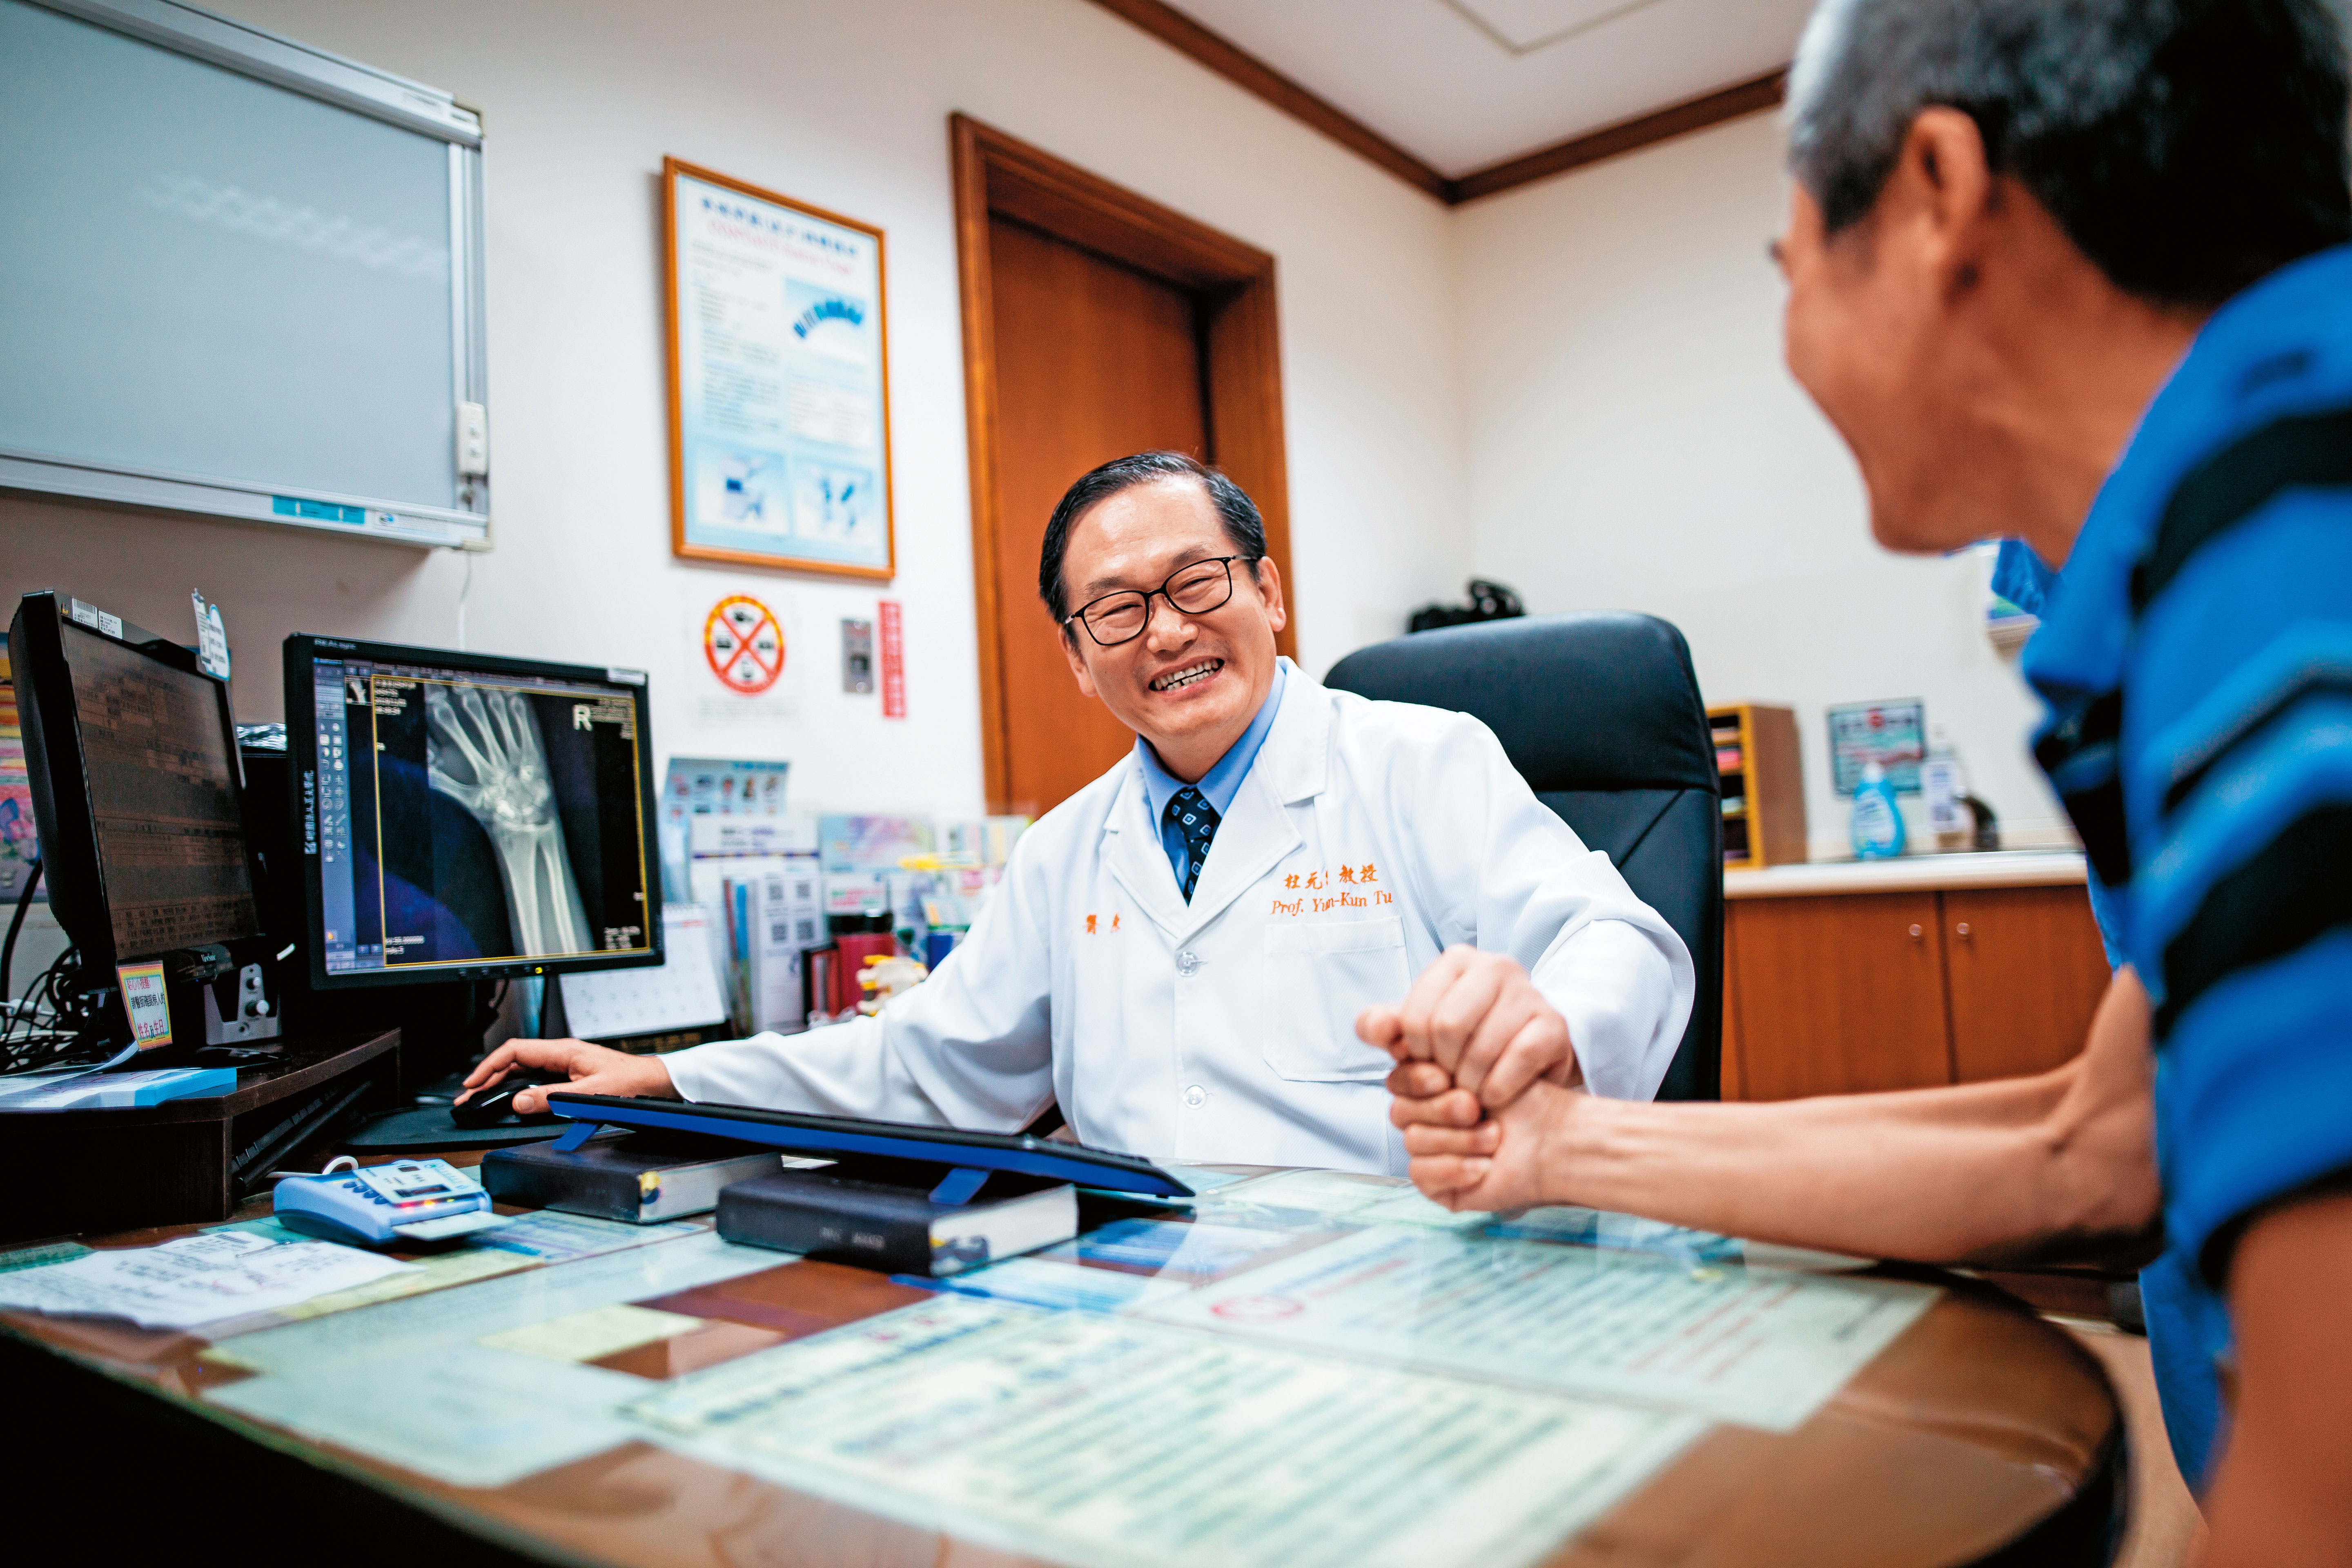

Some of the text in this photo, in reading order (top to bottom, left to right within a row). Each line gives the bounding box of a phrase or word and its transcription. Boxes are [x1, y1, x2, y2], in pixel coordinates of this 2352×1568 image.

[572, 704, 593, 731] R
[1339, 862, 1379, 884] 教授
[1270, 898, 1303, 916] Prof.
[1374, 890, 1393, 905] Tu
[137, 1019, 165, 1040] 姓名及生日
